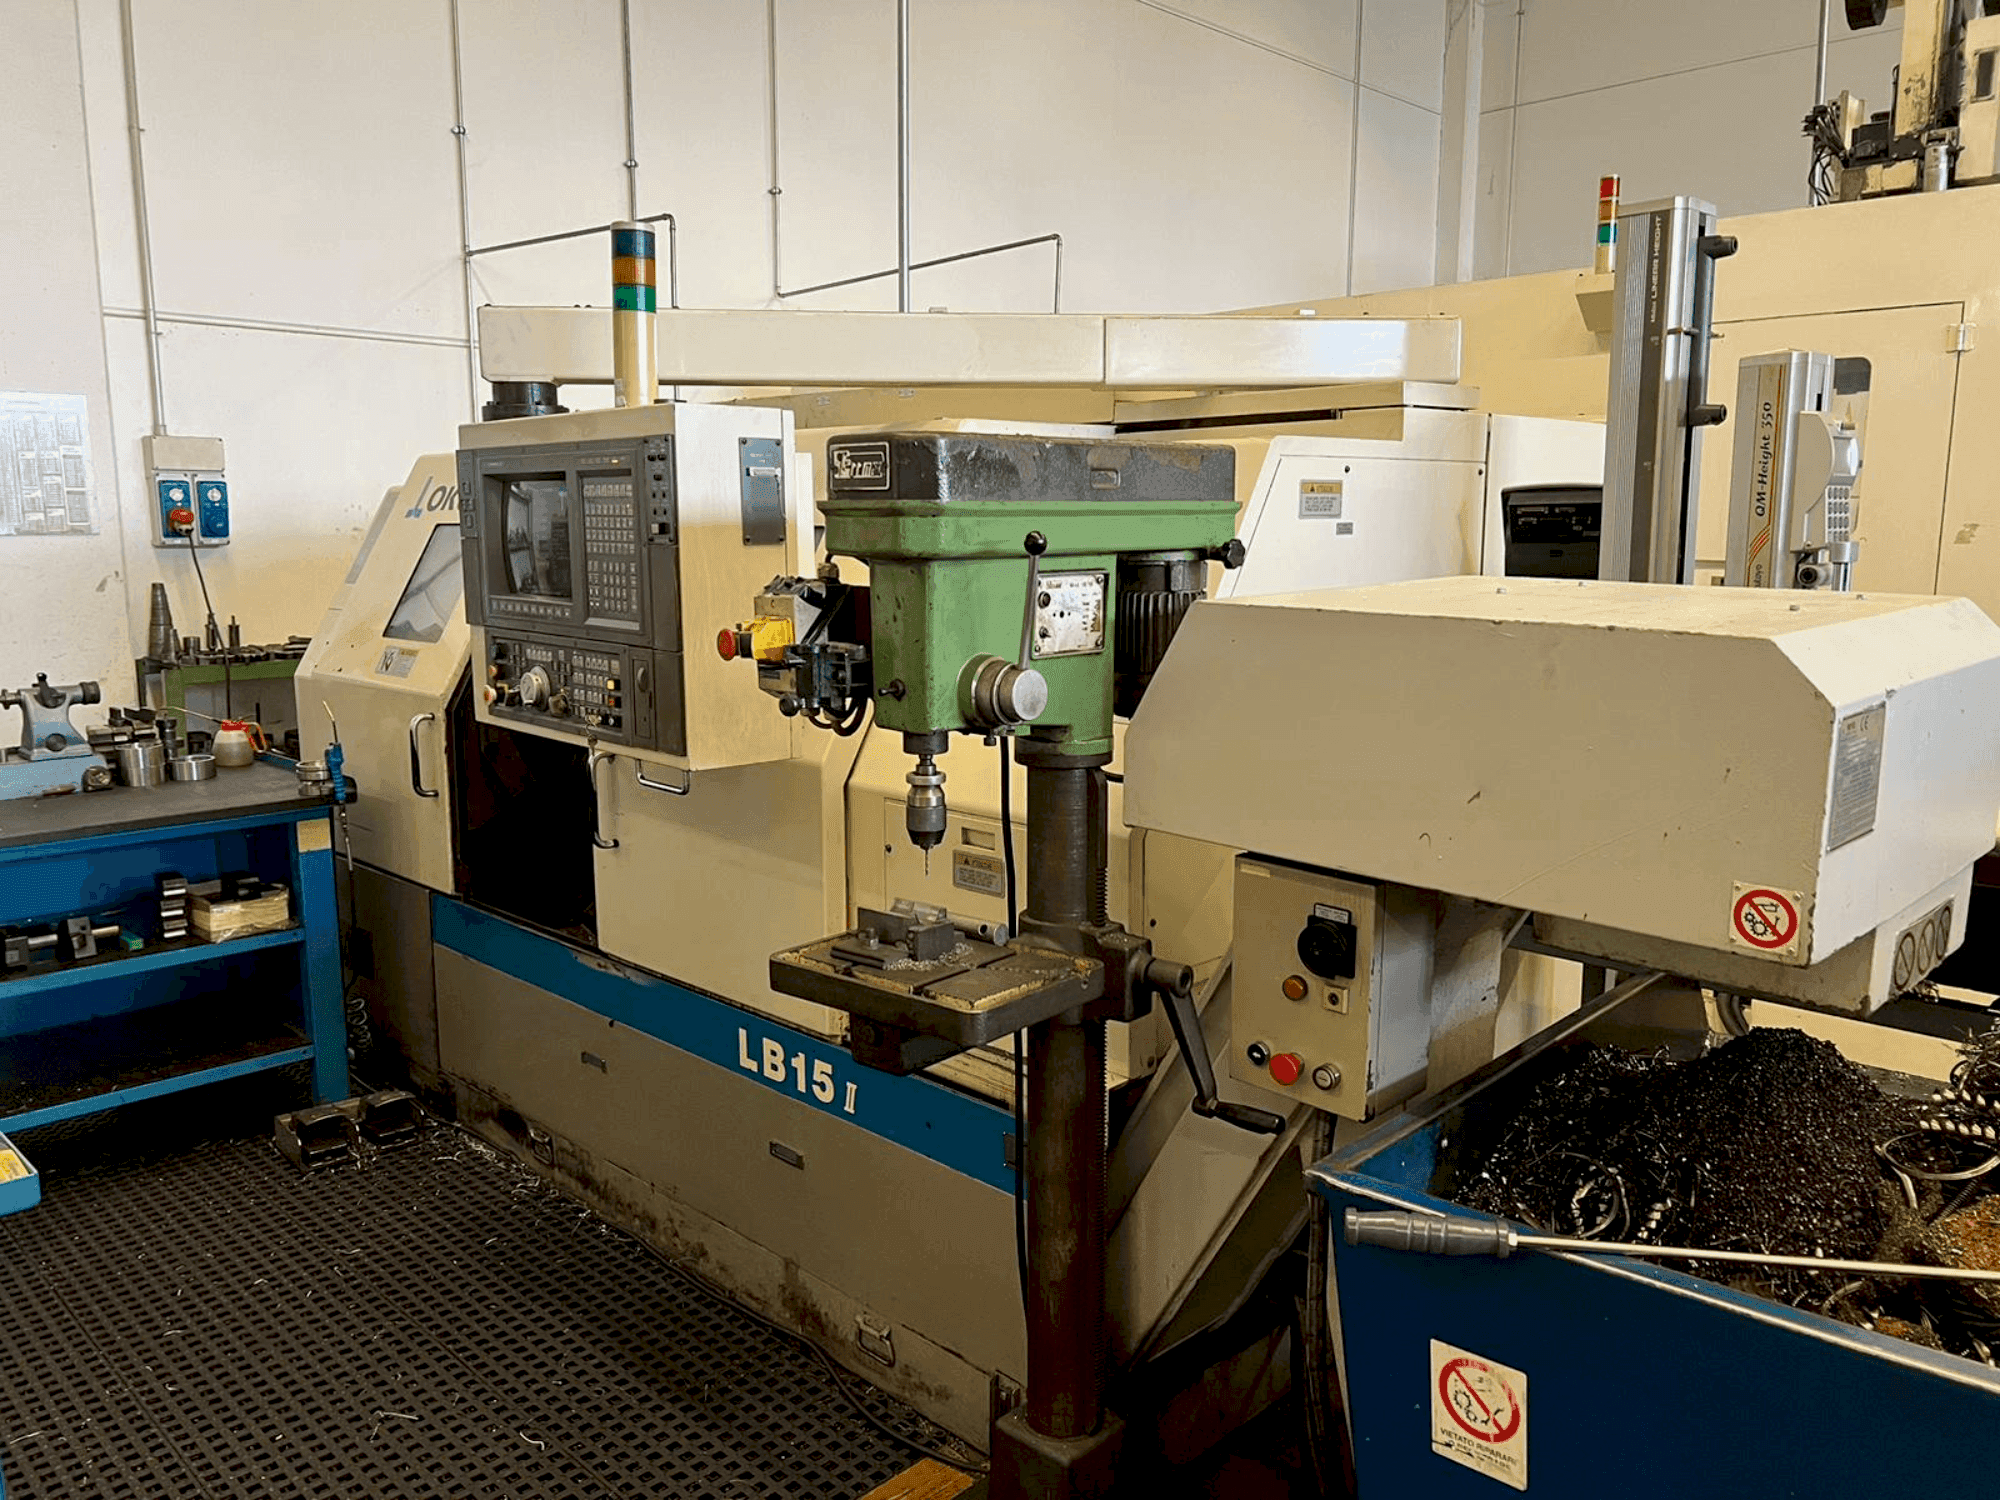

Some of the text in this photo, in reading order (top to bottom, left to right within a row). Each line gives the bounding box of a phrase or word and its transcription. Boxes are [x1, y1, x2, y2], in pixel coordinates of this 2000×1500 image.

[1755, 402, 1774, 518] QM-Height 350
[738, 1027, 835, 1104] LB15
[1440, 1427, 1475, 1447] VIETATO
